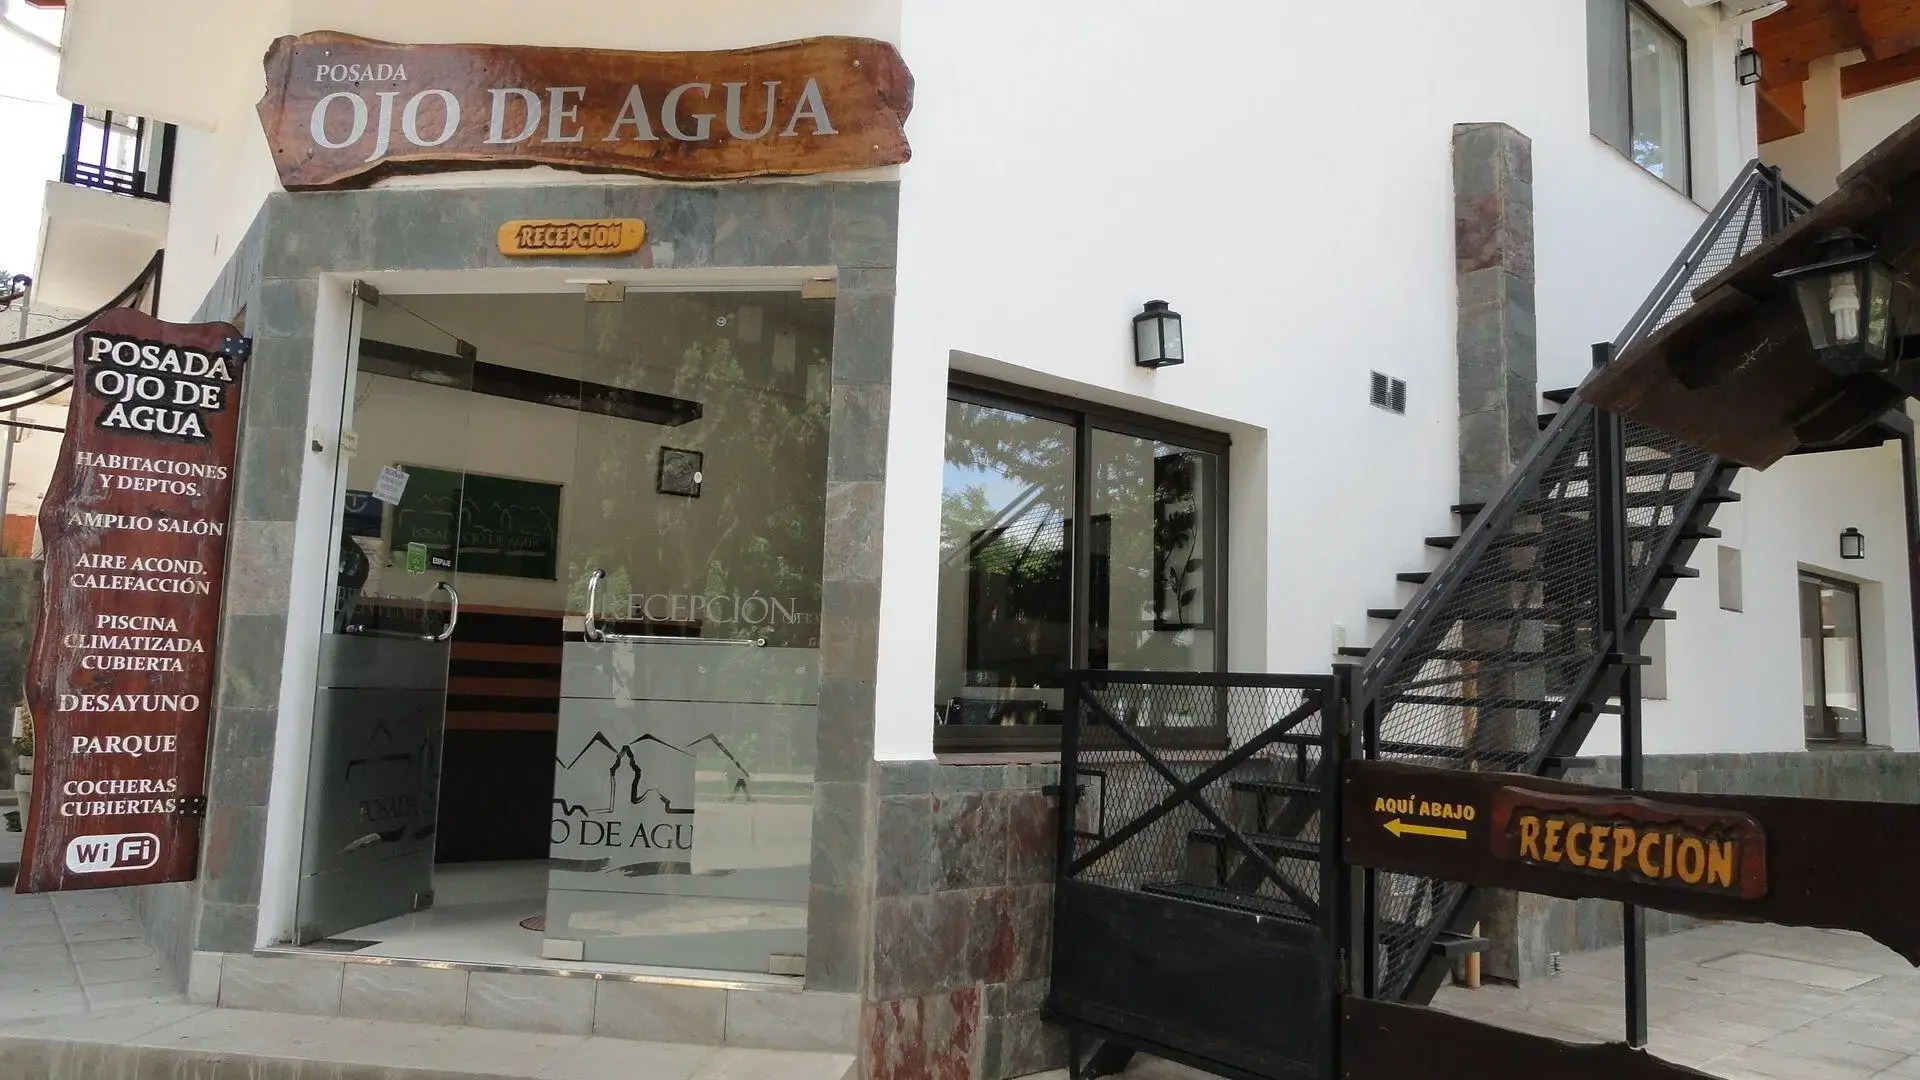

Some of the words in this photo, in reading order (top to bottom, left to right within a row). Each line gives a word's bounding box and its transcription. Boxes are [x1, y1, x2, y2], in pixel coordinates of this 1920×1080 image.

[315, 64, 408, 82] POSADA
[310, 89, 461, 163] OJO
[483, 86, 586, 144] DE
[602, 77, 839, 141] AGUA
[88, 337, 232, 381] POSADA
[95, 370, 165, 403] OJO
[172, 380, 221, 409] DE
[102, 403, 205, 438] AGUA
[76, 452, 228, 480] HABITACIONES
[99, 474, 113, 488] Y
[117, 475, 201, 497] DEPTOS.
[68, 512, 153, 531] AMPLIO
[157, 518, 224, 536] SALÓN
[76, 552, 127, 570] AIRE
[130, 557, 207, 576] ACOND.
[70, 573, 211, 595] CALEFACCIÓN
[601, 589, 797, 625] RECEPCIÓN
[97, 614, 179, 632] PISCINA
[63, 634, 205, 653] CLIMATIZADA
[82, 655, 184, 672] CUBIERTA
[58, 694, 200, 712] DESAYUNO
[71, 735, 177, 758] PARQUE
[63, 778, 177, 796] COCHERAS
[60, 798, 177, 817] CUBIERTAS
[1419, 801, 1475, 820] ABAJO
[579, 820, 622, 847] DE
